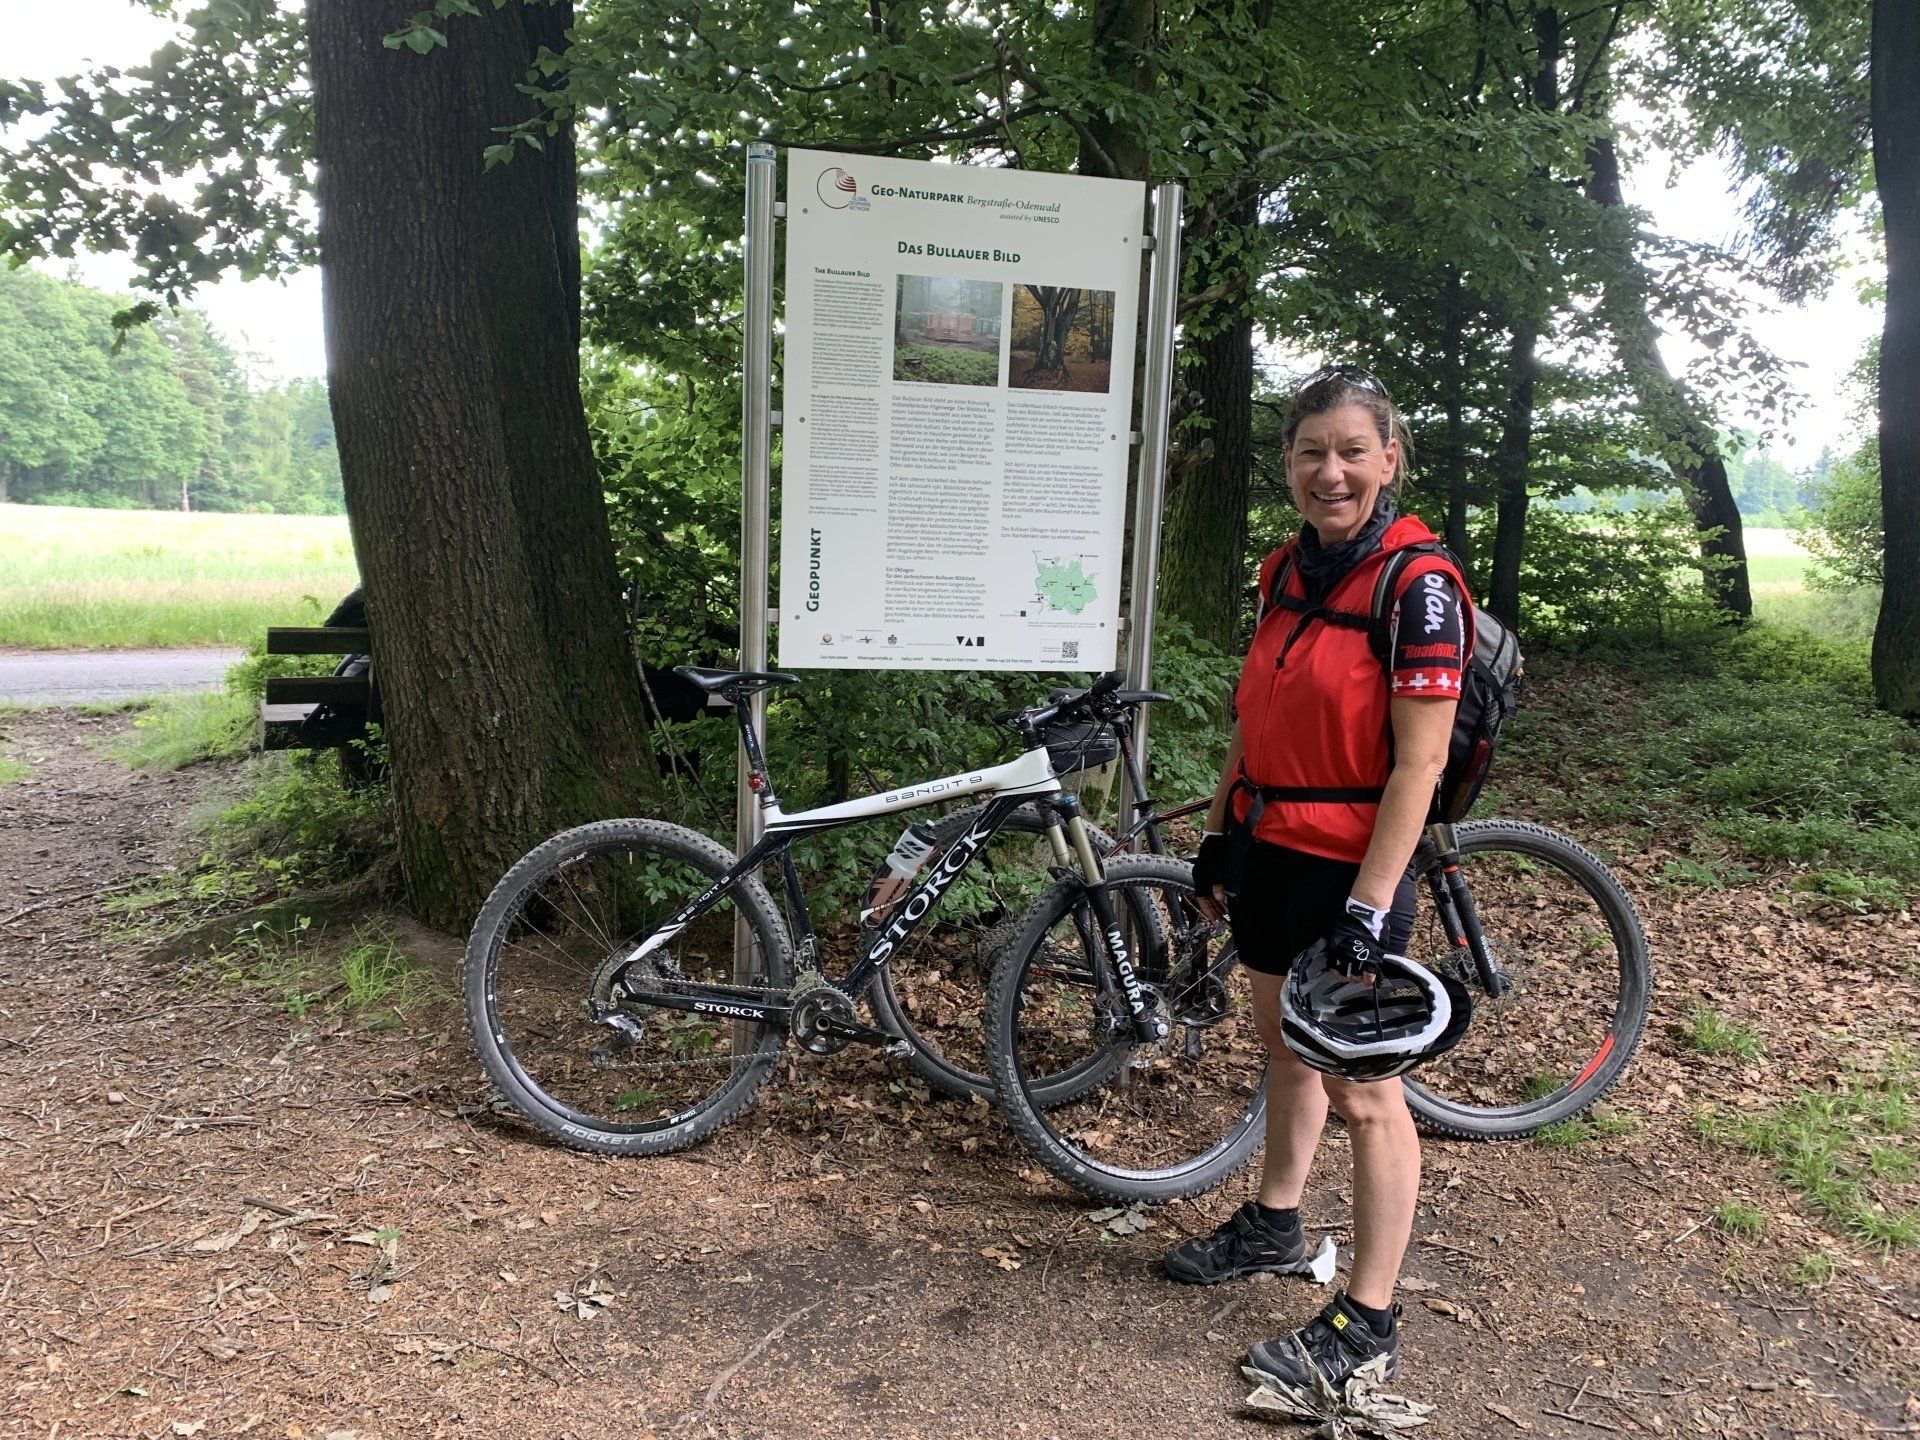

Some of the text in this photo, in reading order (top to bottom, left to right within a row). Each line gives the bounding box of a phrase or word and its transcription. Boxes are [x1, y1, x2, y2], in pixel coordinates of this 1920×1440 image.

[967, 196, 1060, 213] Bergstraße-Odenwald
[898, 241, 1021, 263] DAS BULLAUER BILD
[806, 528, 821, 612] GEOPUNKT
[869, 821, 992, 966] STORCK
[1108, 930, 1144, 1014] MAGURA
[694, 1002, 765, 1018] STORCK
[1005, 1054, 1039, 1127] ROCKET
[680, 1109, 696, 1122] SWISS
[560, 1123, 635, 1146] ROCKET
